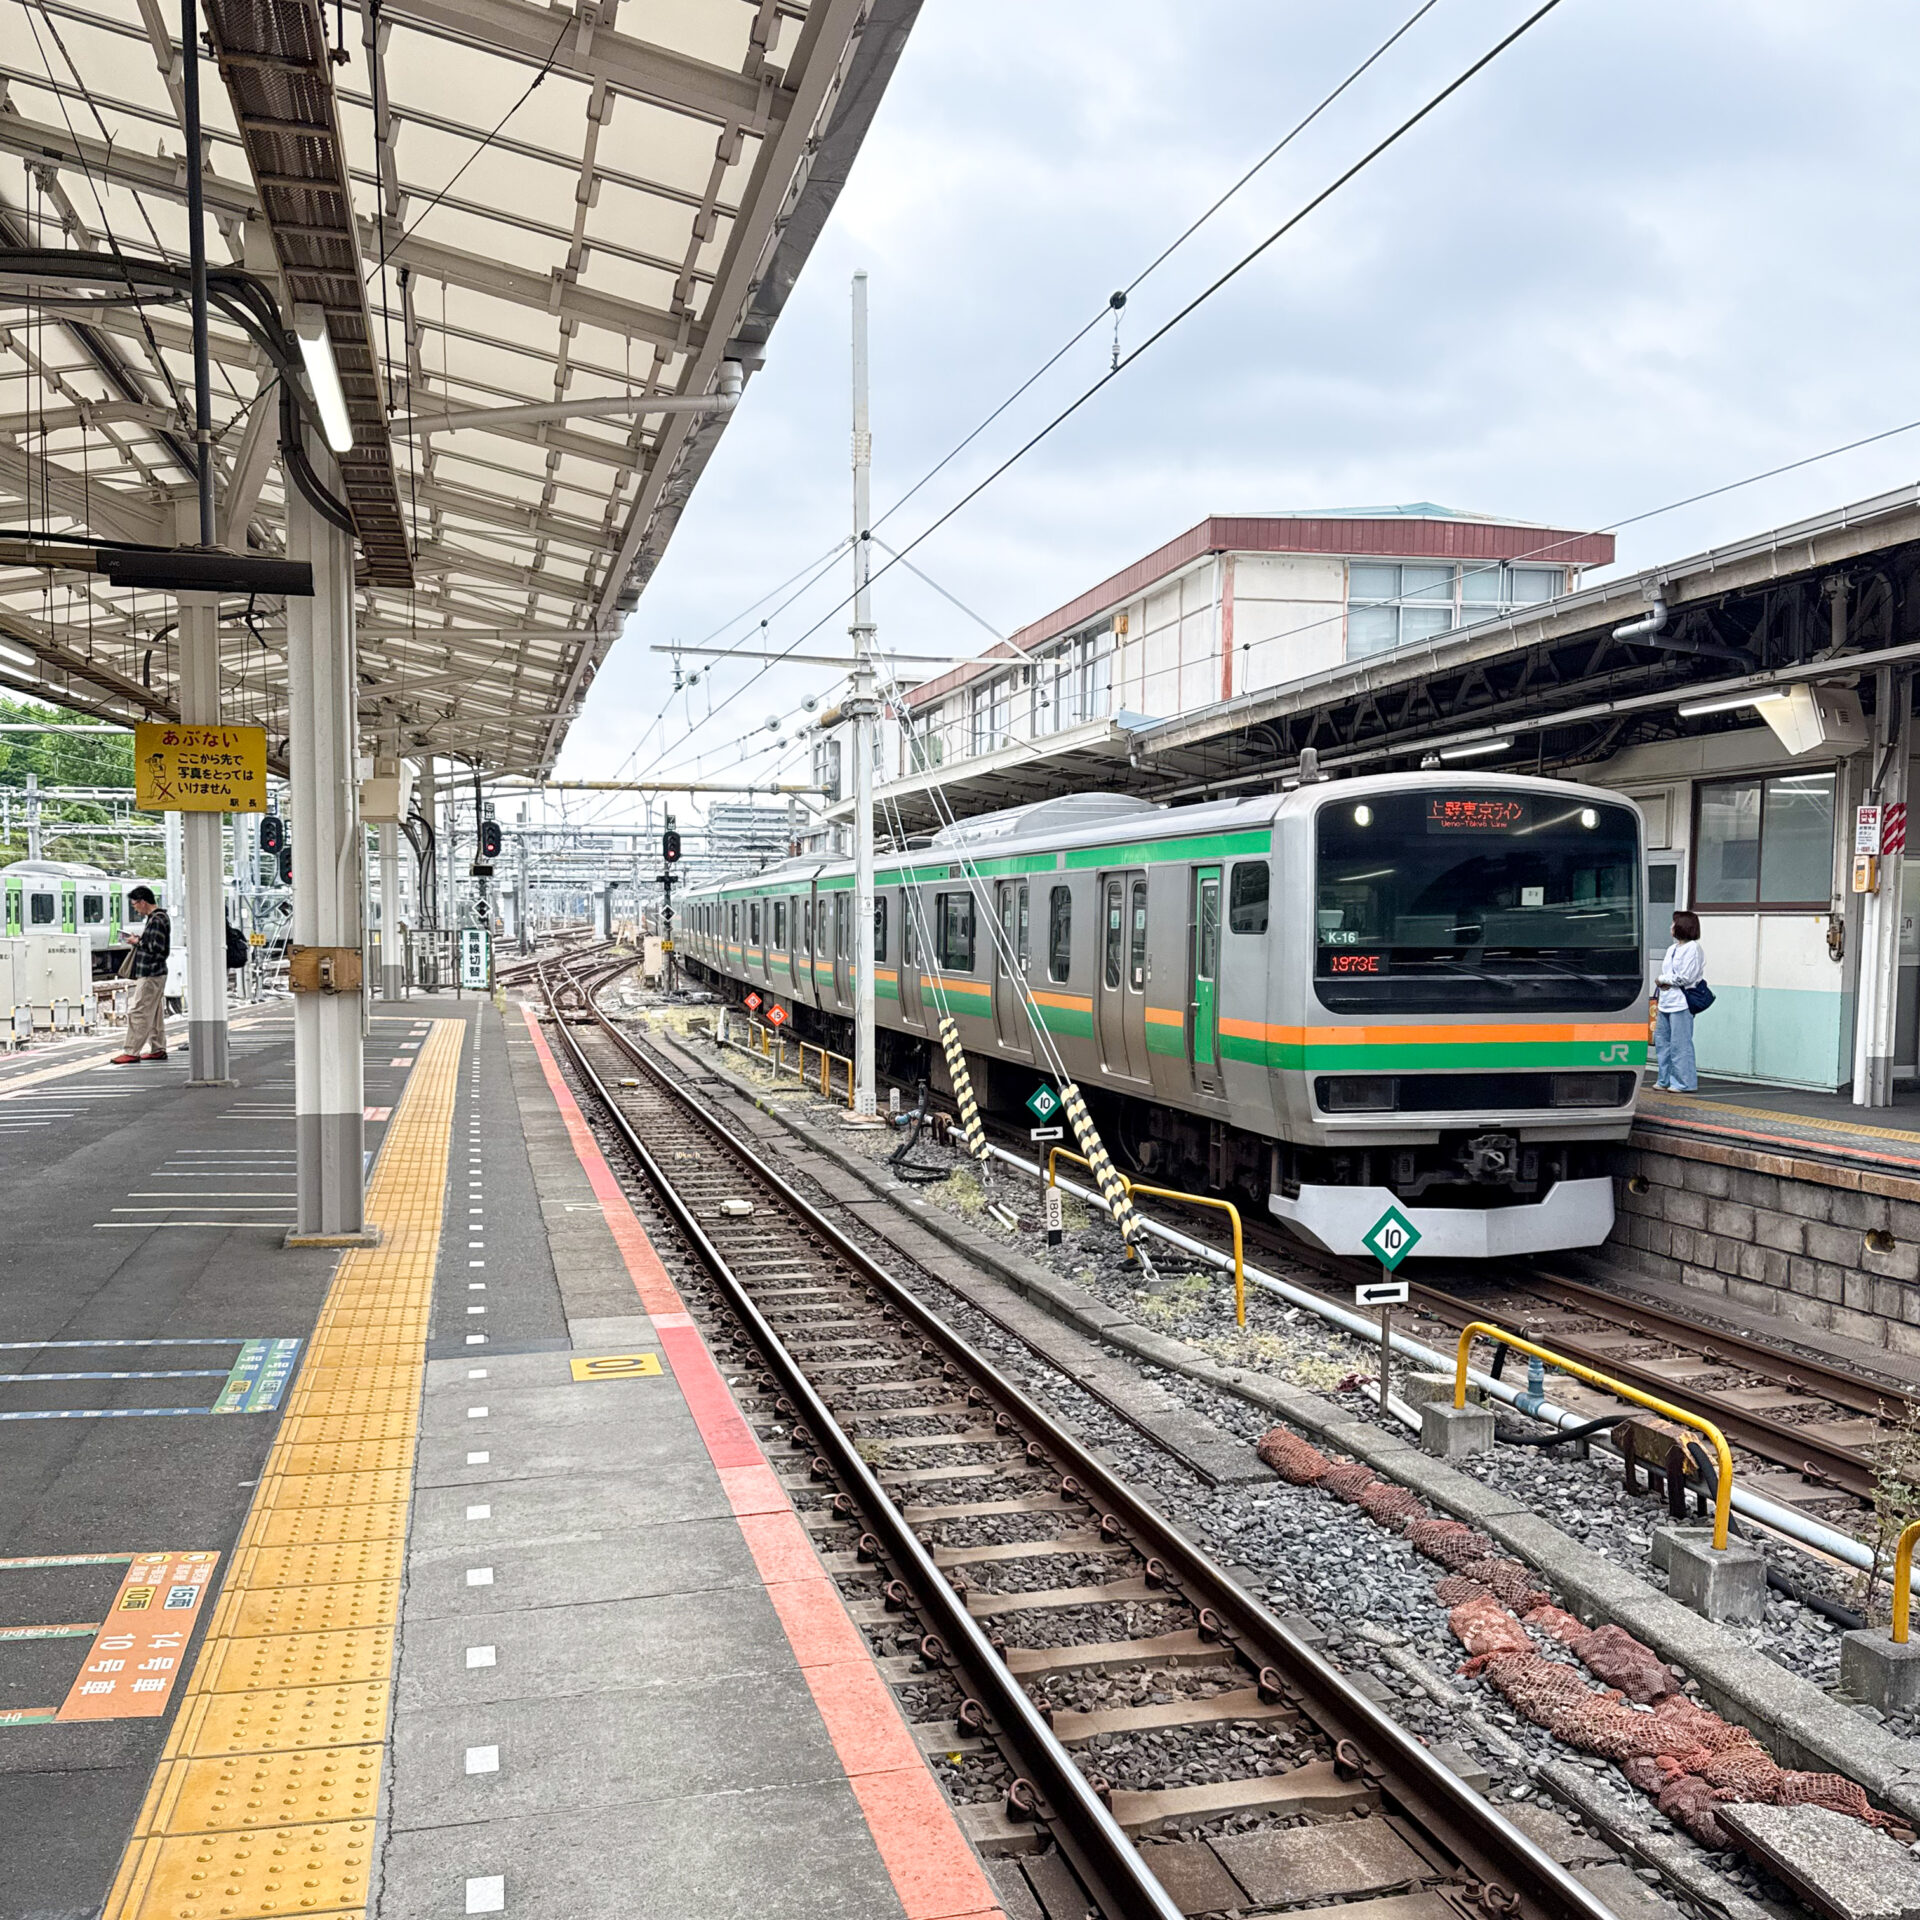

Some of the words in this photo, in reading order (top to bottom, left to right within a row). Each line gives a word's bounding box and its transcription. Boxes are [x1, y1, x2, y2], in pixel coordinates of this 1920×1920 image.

[162, 729, 239, 748] あぶない
[177, 752, 244, 766] ここから先で
[178, 766, 254, 780] 写真をとっては
[178, 782, 231, 795] いけません
[1427, 800, 1524, 820] 上野東京ライン
[1328, 932, 1356, 944] K-16
[469, 932, 481, 977] 無線切替
[1600, 1044, 1629, 1062] JR
[1039, 1097, 1051, 1109] 10
[1049, 1198, 1059, 1227] 1800
[1384, 1228, 1402, 1249] 10
[122, 1588, 151, 1609] 10両
[167, 1587, 196, 1607] 15両
[78, 1632, 137, 1696] 10号車
[130, 1631, 184, 1693] 14号車
